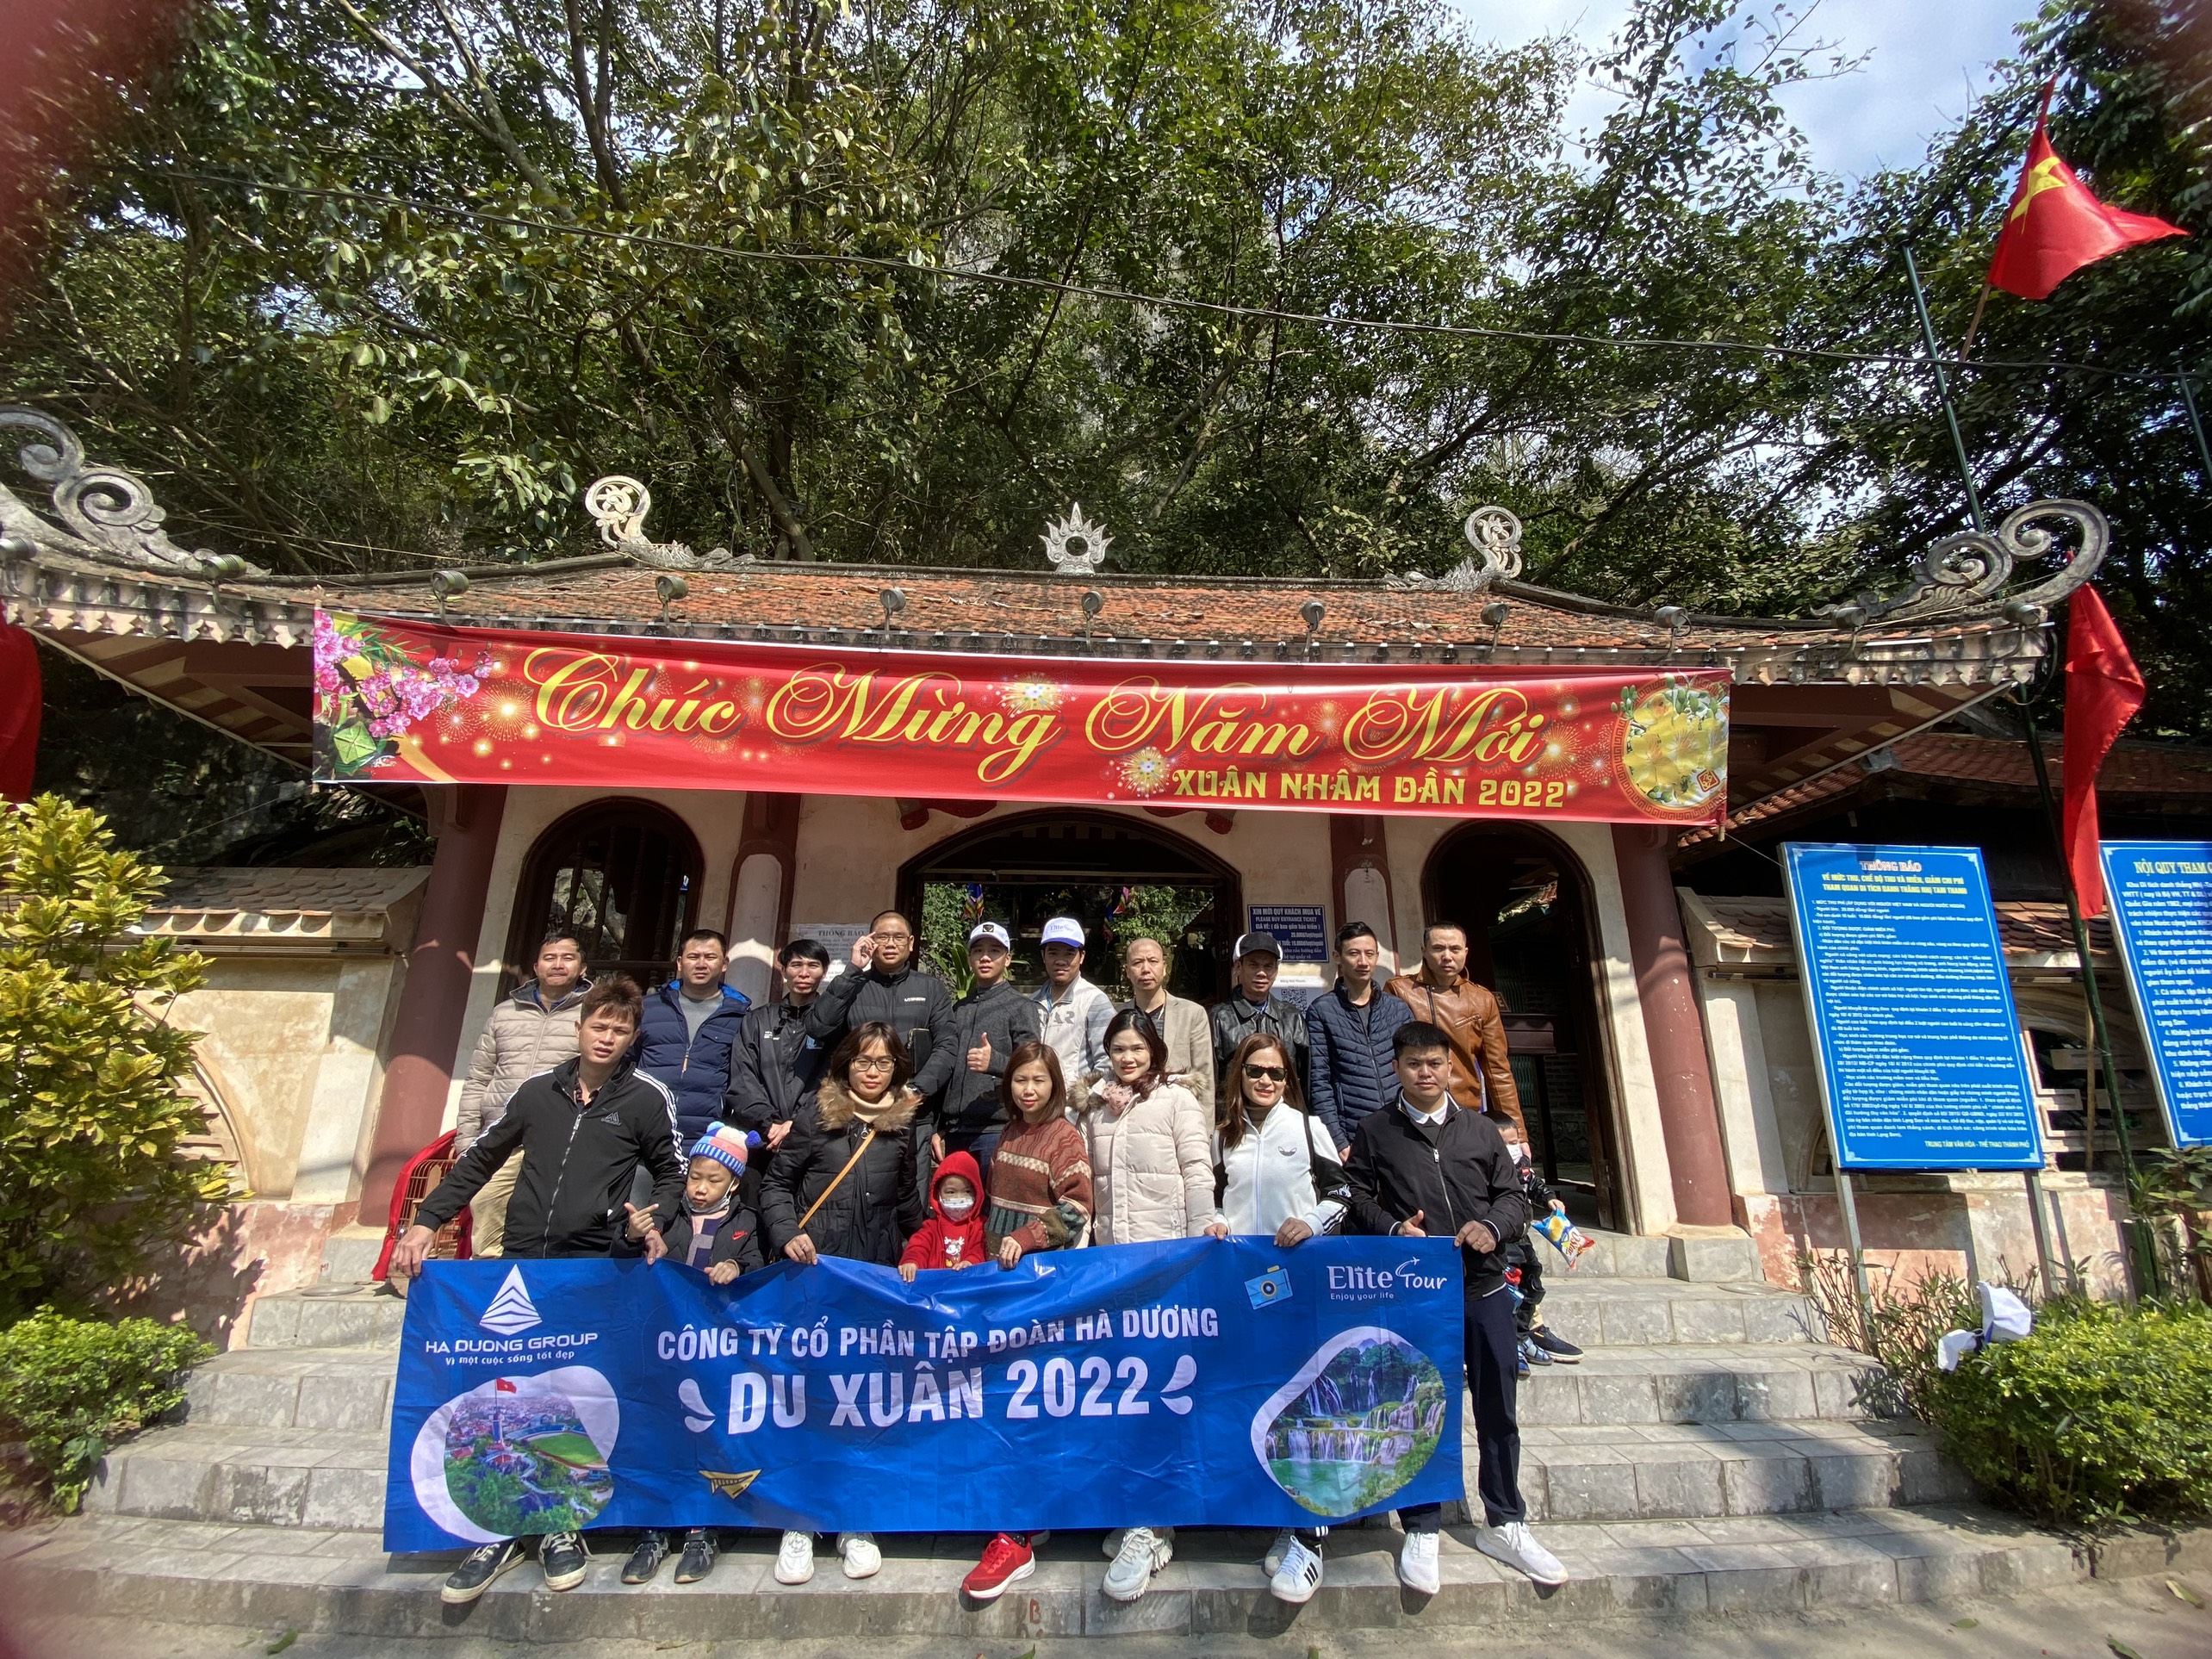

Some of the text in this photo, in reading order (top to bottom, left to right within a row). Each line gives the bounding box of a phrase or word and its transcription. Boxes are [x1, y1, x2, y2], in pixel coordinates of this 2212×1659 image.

[523, 647, 1545, 783] Chúc Mừng Năm Mới
[1172, 765, 1564, 807] XUÂN NHÂM DẦN 2022
[2133, 858, 2154, 876] NỘI
[2155, 861, 2177, 874] QUY
[2177, 861, 2208, 873] THAM
[1327, 1264, 1448, 1289] Elite Tour
[1357, 1293, 1376, 1302] your
[426, 1333, 599, 1353] HA DUONG GROUP
[657, 1304, 1220, 1362] CÔNG TY CỔ PHẦN TẬP ĐOÀN HÀ DƯƠNG
[459, 1356, 478, 1365] một
[482, 1356, 504, 1366] cuộc
[507, 1353, 533, 1364] sống
[537, 1351, 551, 1360] tốt
[556, 1350, 575, 1360] đẹp
[727, 1356, 1150, 1435] DU XUÂN 2022
